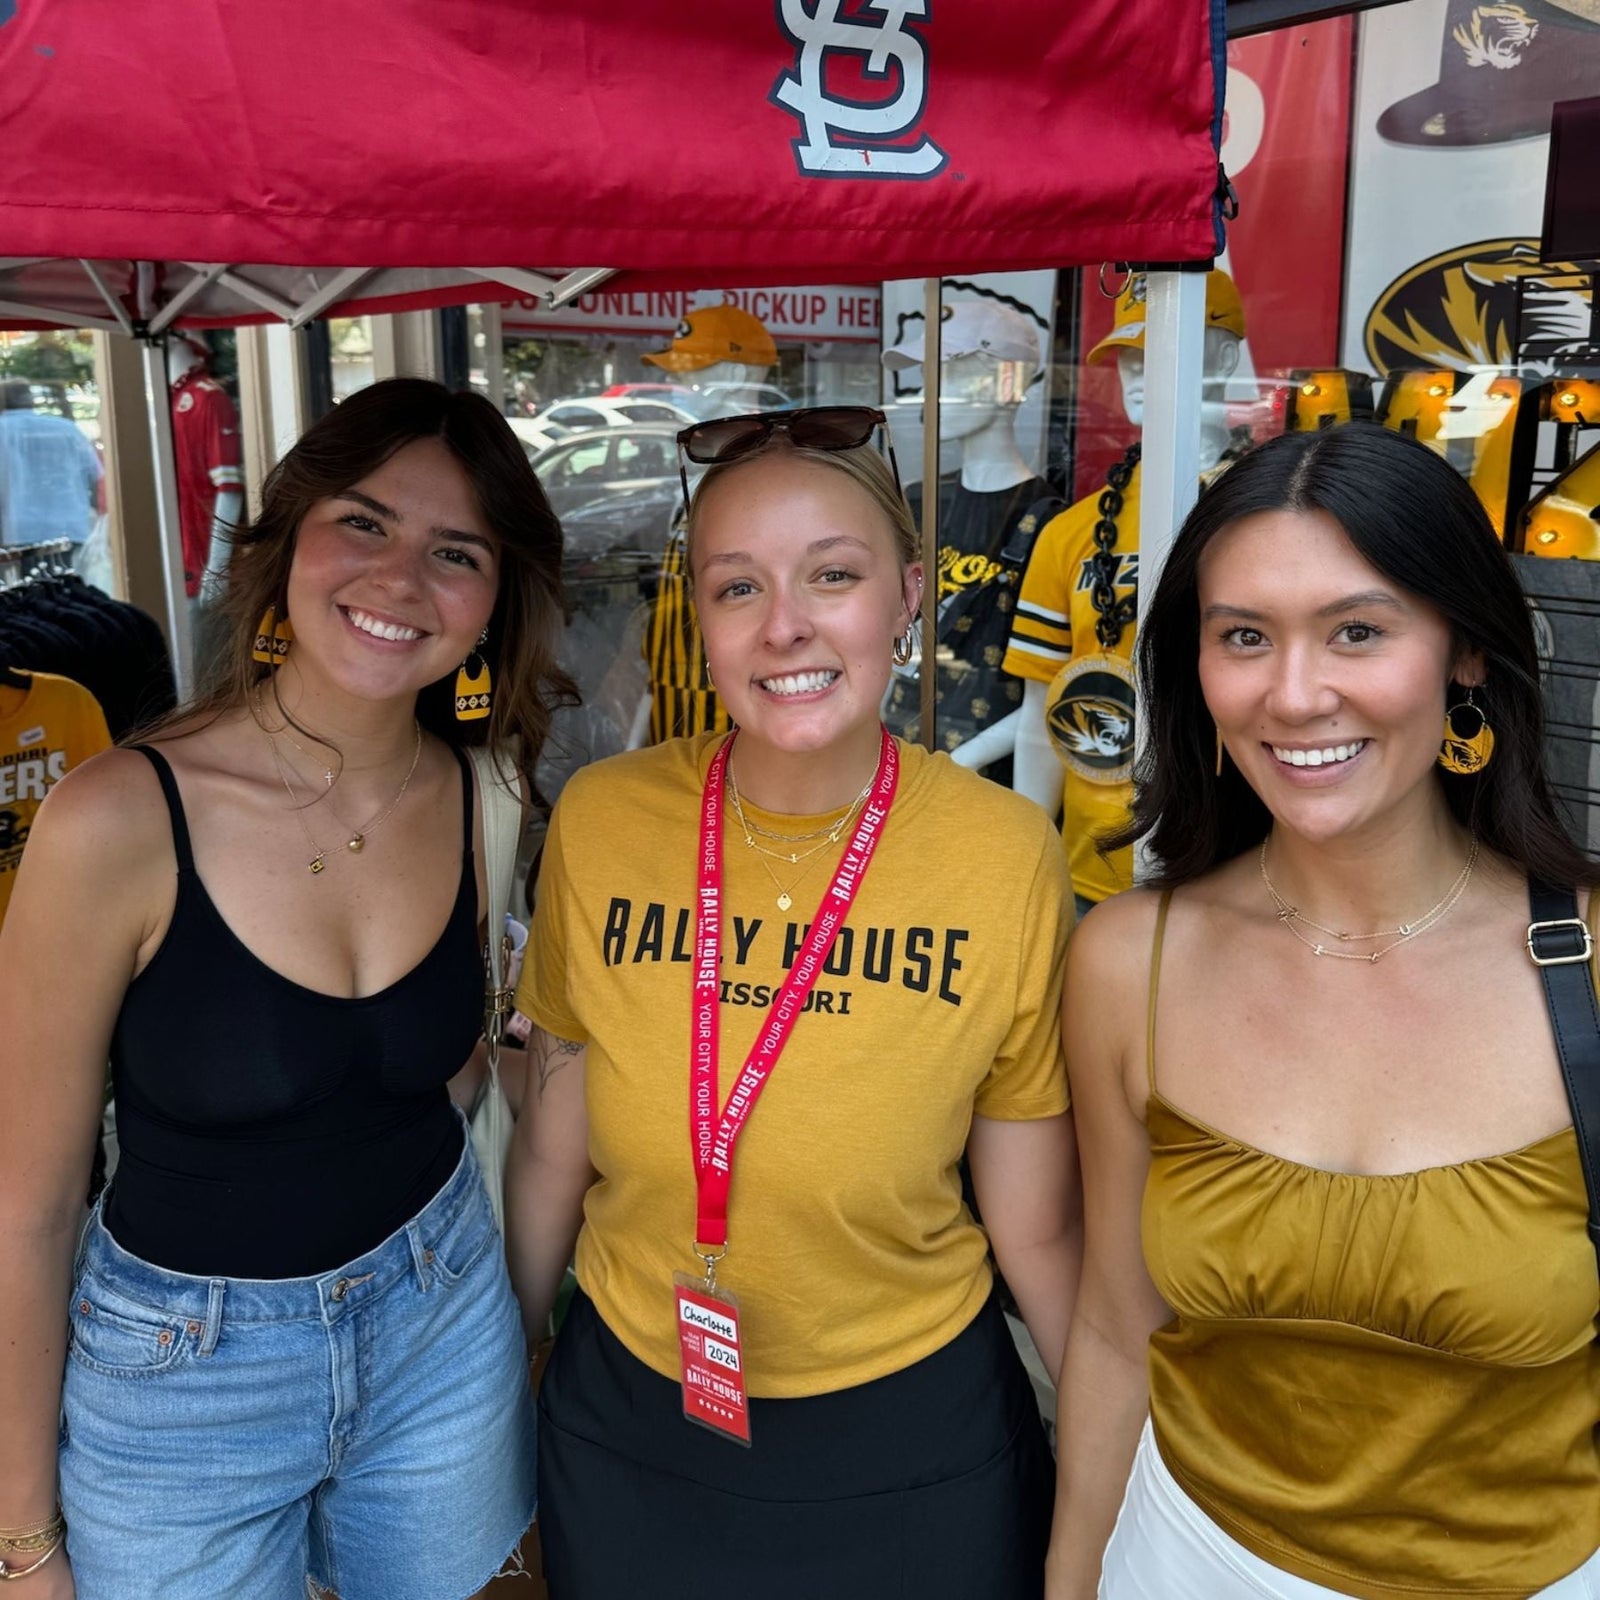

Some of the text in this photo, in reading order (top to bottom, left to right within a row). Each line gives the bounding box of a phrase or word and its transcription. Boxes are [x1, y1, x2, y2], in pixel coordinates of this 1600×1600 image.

[879, 766, 895, 796] YOUR
[706, 794, 717, 827] YOUR
[704, 830, 716, 875] HOUSE.
[831, 801, 887, 902] RALLY HOUSE
[603, 897, 763, 967] RALY
[696, 887, 719, 991] RALLY HOUSE
[698, 1003, 712, 1038] YOUR
[760, 1021, 785, 1055] YOUR
[793, 954, 818, 987] YOUR
[697, 1079, 710, 1117] YOUR
[711, 1061, 766, 1171] RALLY HOUSE
[683, 1305, 733, 1338] Charlotte
[708, 1345, 738, 1369] 2024
[686, 1368, 712, 1388] RALLY
[712, 1381, 743, 1407] HOUSE
